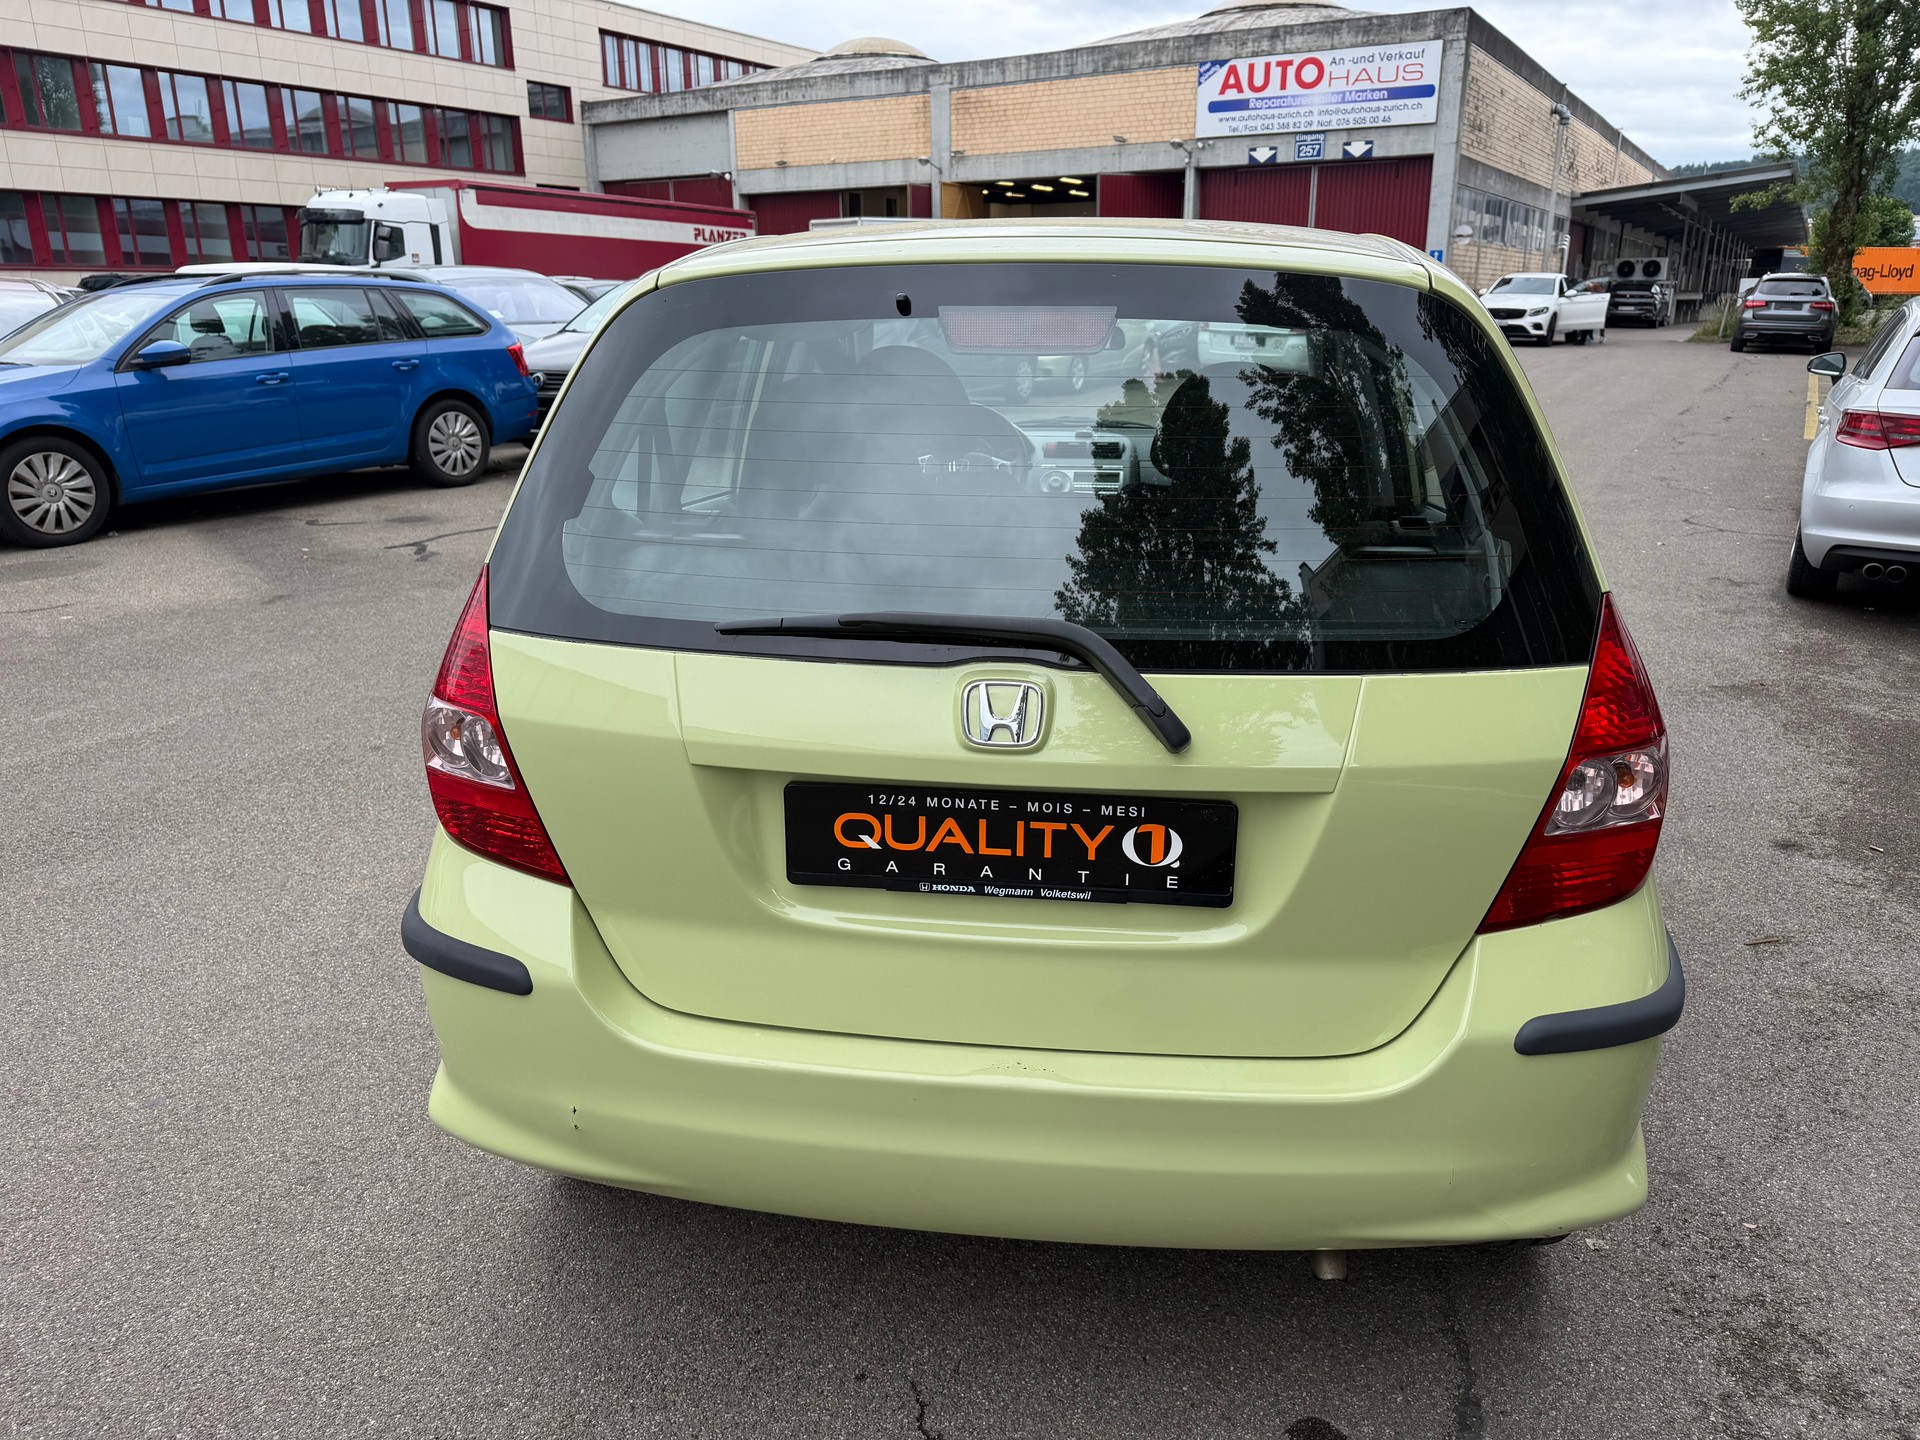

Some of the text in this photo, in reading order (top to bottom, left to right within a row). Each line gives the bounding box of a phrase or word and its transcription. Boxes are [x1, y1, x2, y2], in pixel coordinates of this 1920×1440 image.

[1329, 56, 1345, 66] An
[1378, 48, 1425, 62] Verkauf
[1218, 56, 1325, 96] AUTO
[1328, 63, 1424, 87] HAUS
[1344, 89, 1388, 102] Marken
[1299, 145, 1320, 157] 257
[868, 794, 916, 806] 12/24
[926, 797, 1000, 811] MONATE
[1027, 802, 1073, 814] MOIS
[1101, 805, 1145, 818] MESI
[834, 812, 1115, 861] QUALITY
[837, 857, 1179, 889] GARANTIE
[932, 883, 1091, 900] HONDA Wegmann Volketswil
